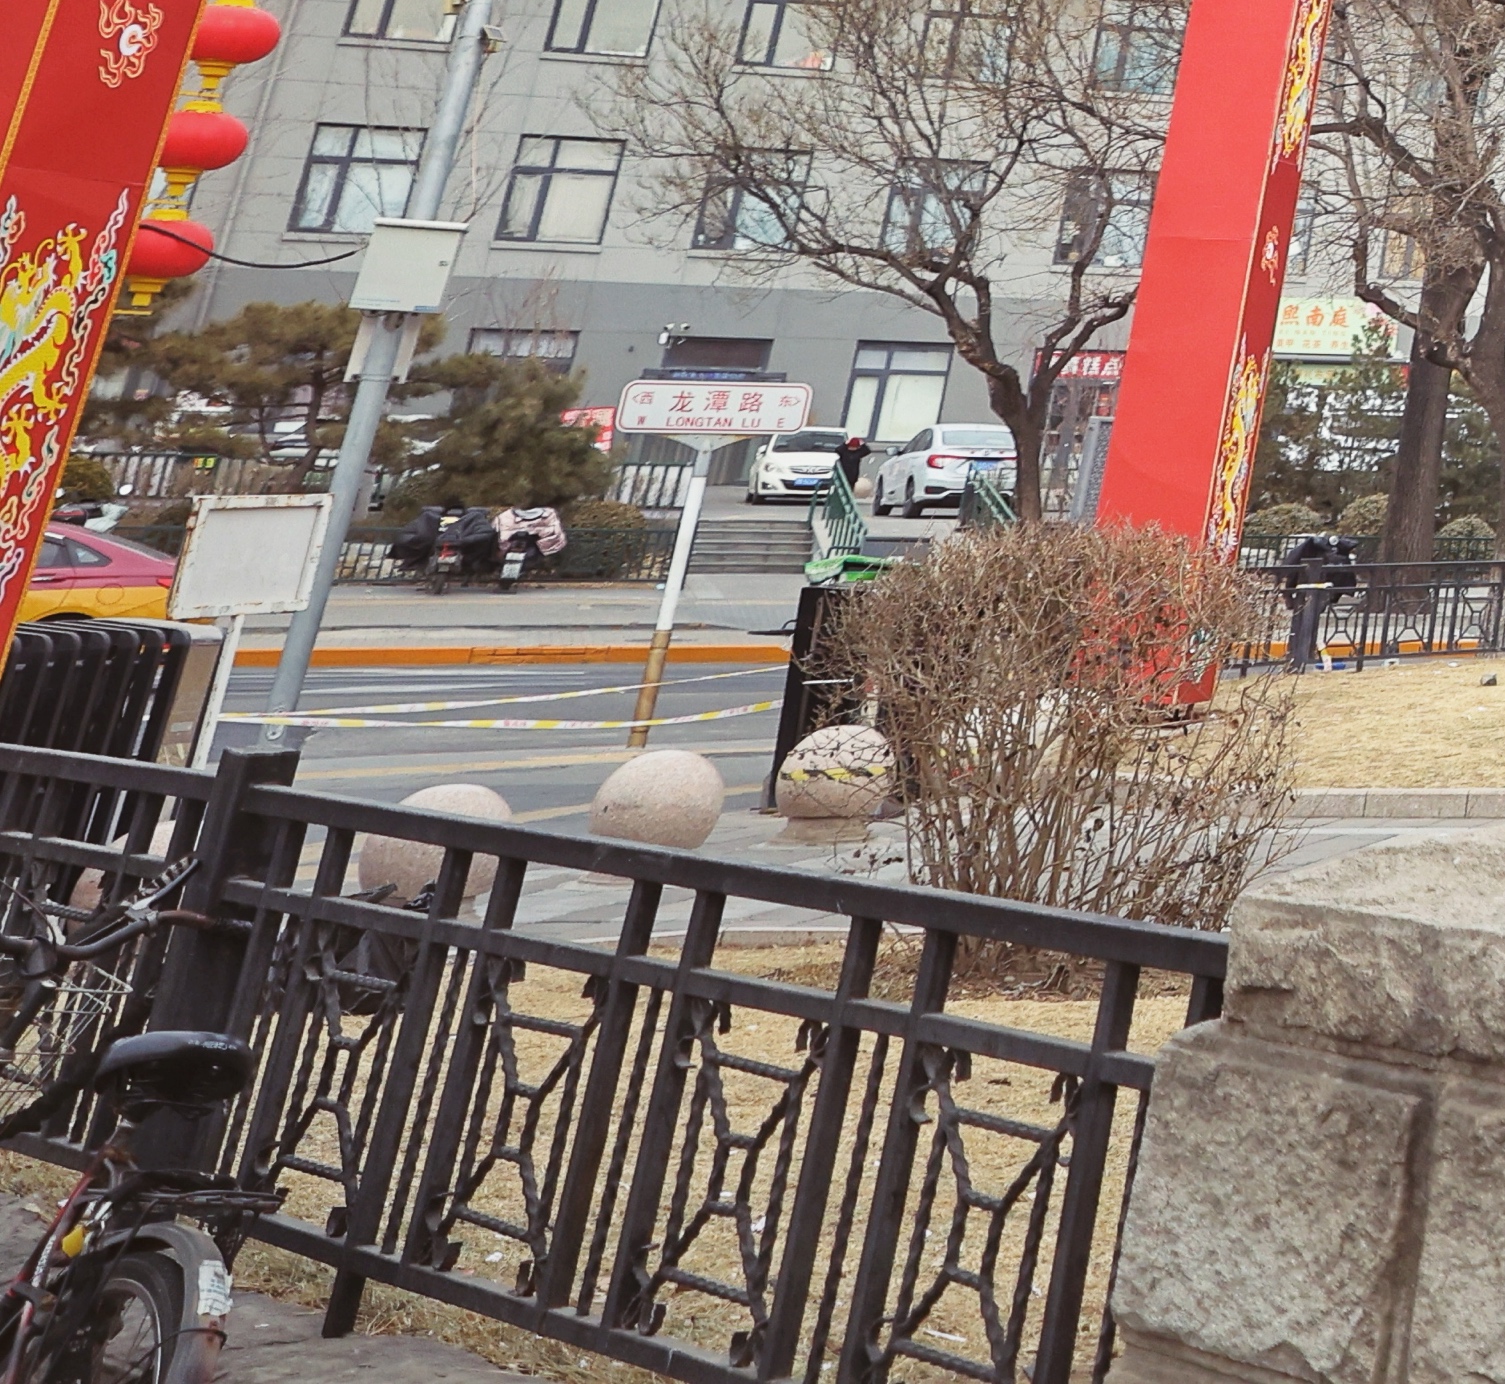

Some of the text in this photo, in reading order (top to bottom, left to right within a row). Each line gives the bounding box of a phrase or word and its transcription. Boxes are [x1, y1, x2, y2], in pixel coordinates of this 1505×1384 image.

[669, 390, 763, 412] 龙潭路
[637, 416, 785, 427] W LONGTAN LU E
